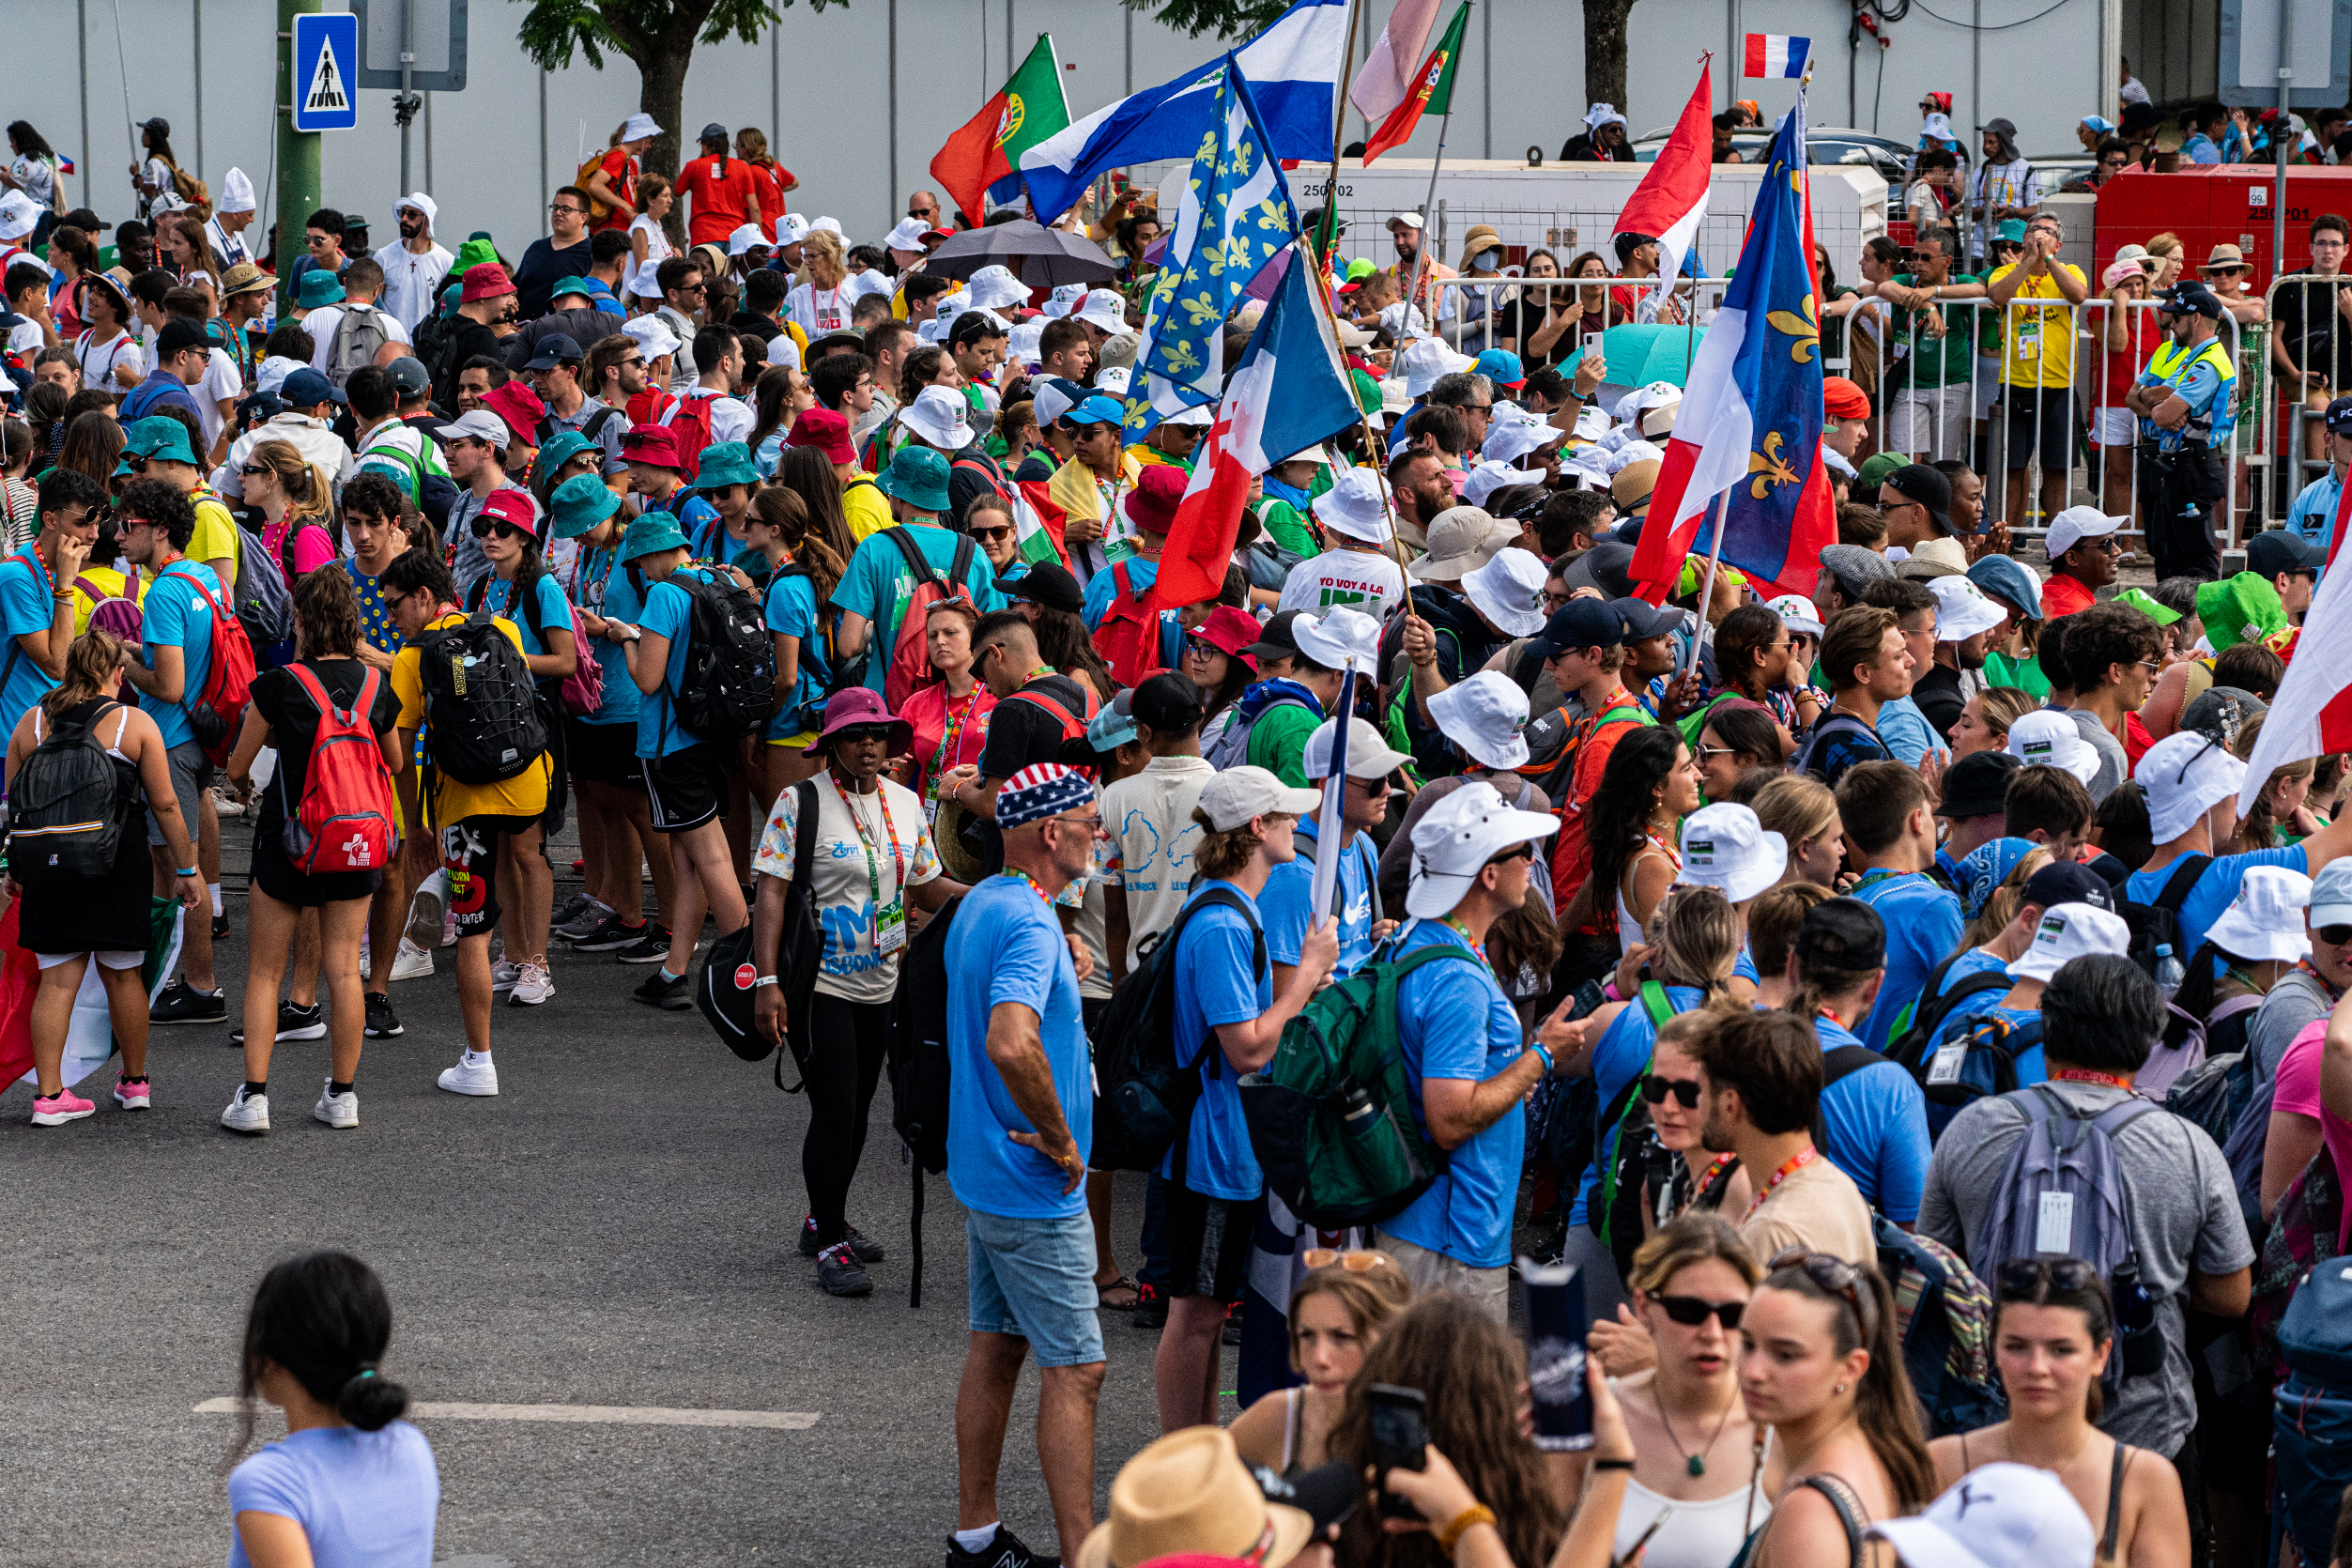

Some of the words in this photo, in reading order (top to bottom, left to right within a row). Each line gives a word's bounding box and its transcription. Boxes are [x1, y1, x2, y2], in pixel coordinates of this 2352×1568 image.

[1303, 185, 1353, 196] 25002
[1320, 577, 1333, 586] YO
[1336, 578, 1358, 590] VOY
[1359, 582, 1367, 592] A
[1369, 584, 1383, 594] LA
[890, 915, 903, 925] A27
